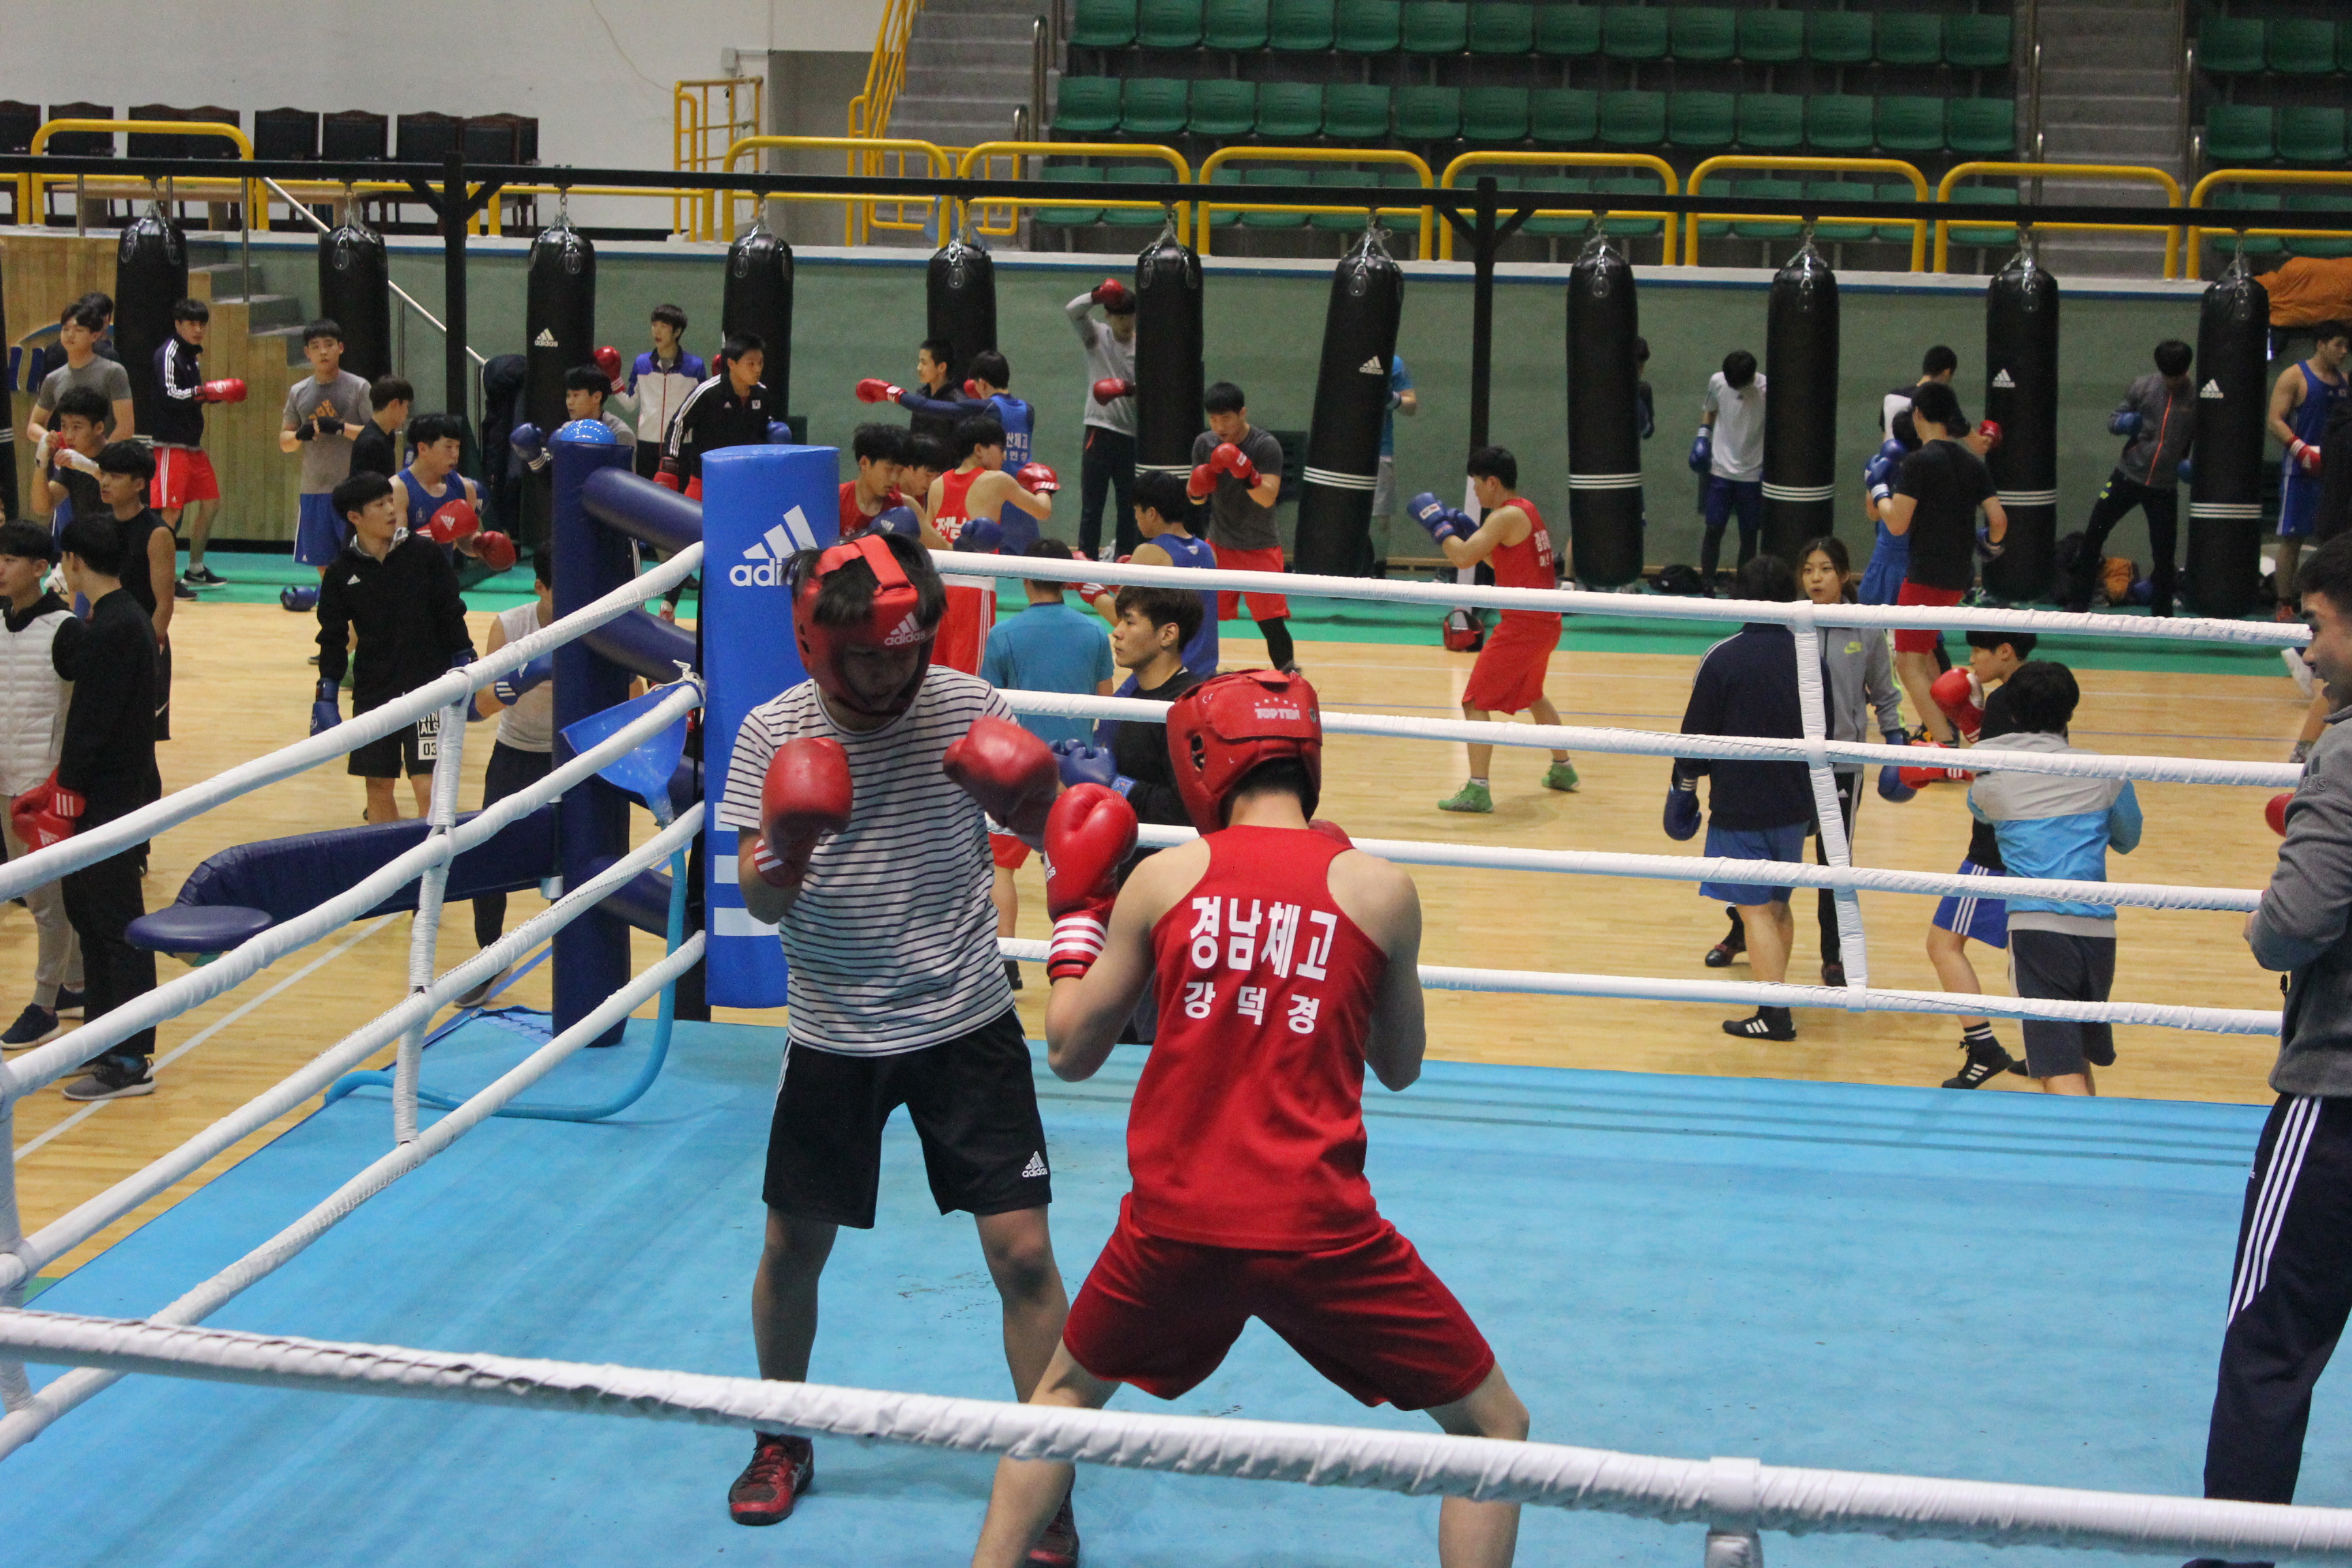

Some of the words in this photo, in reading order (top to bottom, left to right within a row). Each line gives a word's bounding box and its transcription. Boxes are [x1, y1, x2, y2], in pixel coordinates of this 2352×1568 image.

[730, 557, 793, 587] adi
[884, 630, 926, 647] adidas
[1190, 896, 1338, 981] 경남체고
[1022, 1167, 1048, 1178] adidas
